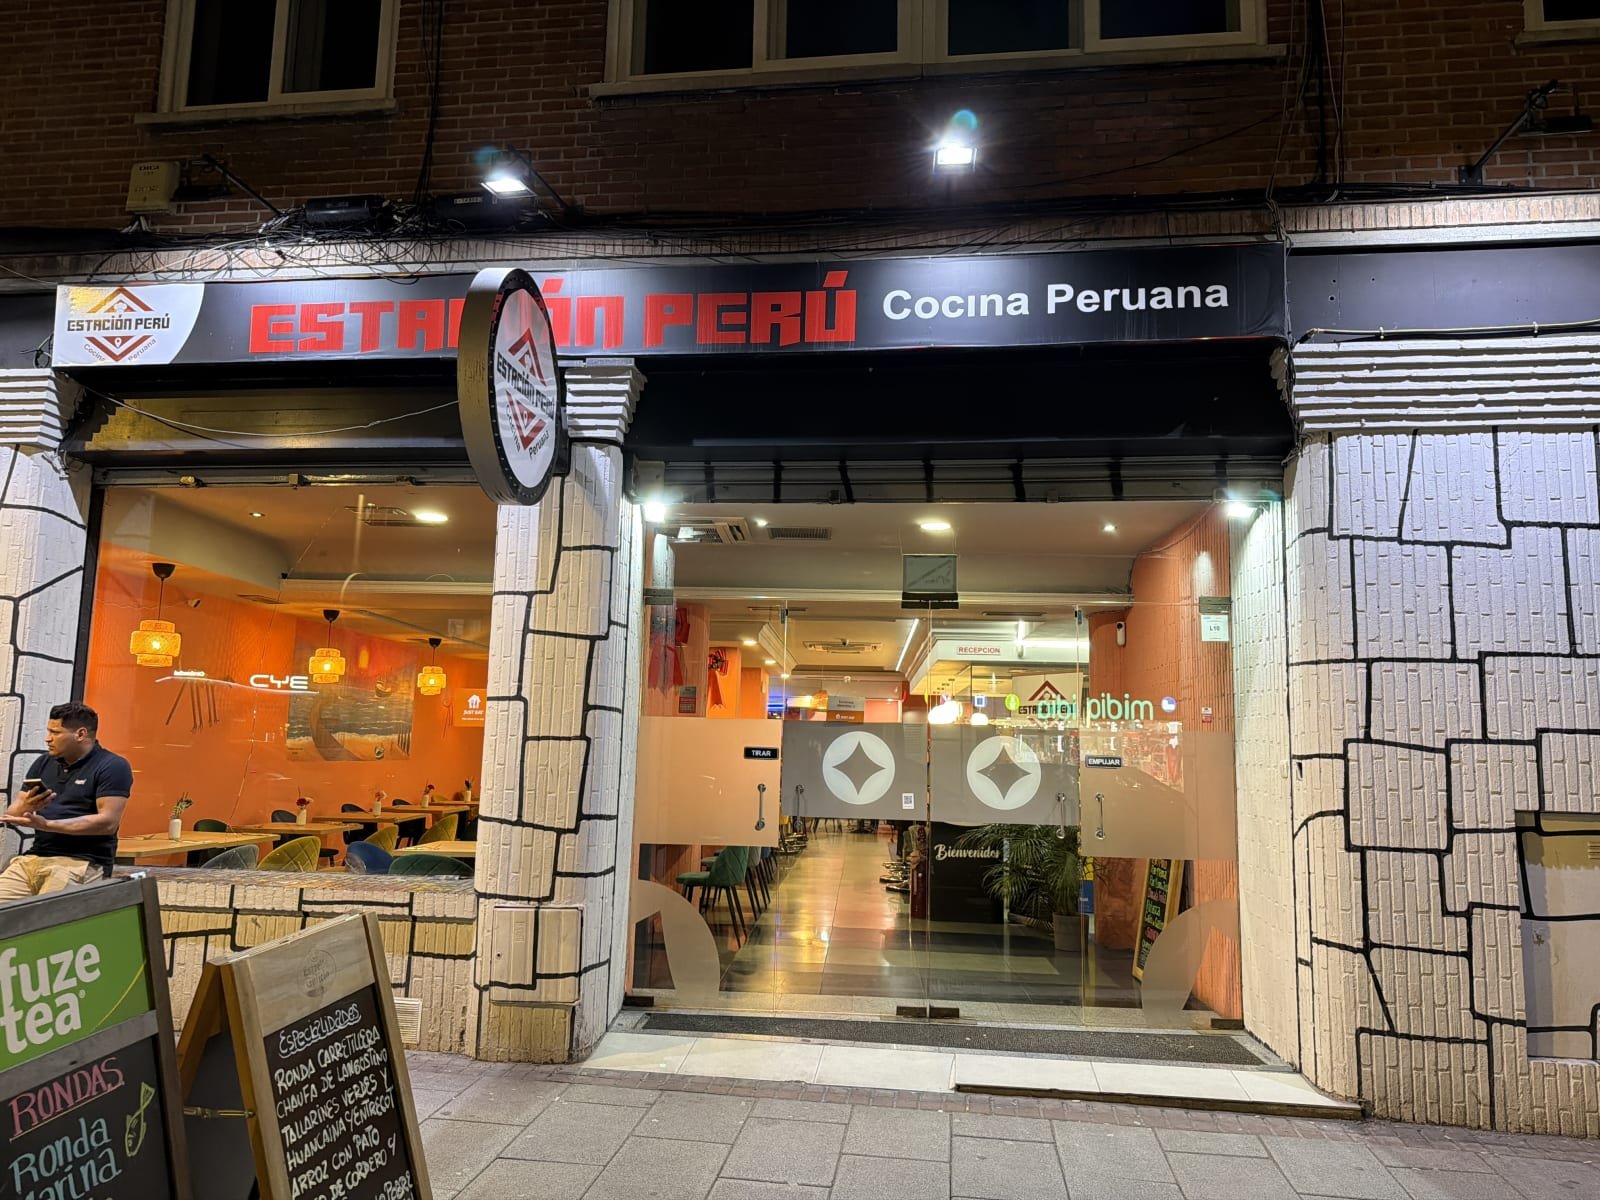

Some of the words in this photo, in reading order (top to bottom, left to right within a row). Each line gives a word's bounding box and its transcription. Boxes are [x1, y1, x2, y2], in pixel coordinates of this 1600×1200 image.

[67, 314, 132, 332] ESTACIÓN
[134, 313, 170, 330] PERÚ
[248, 278, 624, 354] ESTAN
[644, 270, 857, 347] PERÚ
[882, 289, 1030, 320] Cocina
[1047, 283, 1229, 314] Peruana
[496, 351, 535, 405] ESTACIÓN
[958, 646, 1001, 654] RECEPCION
[751, 749, 771, 757] TIRAR
[1088, 758, 1120, 766] EMPUJAR
[0, 943, 101, 1005] fuze
[0, 992, 82, 1054] tea
[274, 1058, 316, 1095] RONDA
[317, 1025, 381, 1068] CARRETILLERA
[8, 1056, 125, 1137] RONDAS
[276, 1083, 318, 1119] CHAUFA
[320, 1069, 336, 1093] DE
[281, 1097, 340, 1148] TALLARINES
[341, 1073, 378, 1107] VERDES
[379, 1067, 389, 1090] Y
[8, 1117, 112, 1195] Ronda
[24, 1147, 123, 1200] rina
[291, 1160, 330, 1200] ARROZ
[331, 1144, 353, 1171] CON
[352, 1124, 380, 1157] PATO
[329, 1178, 346, 1200] DE
[345, 1149, 387, 1190] CORDERO
